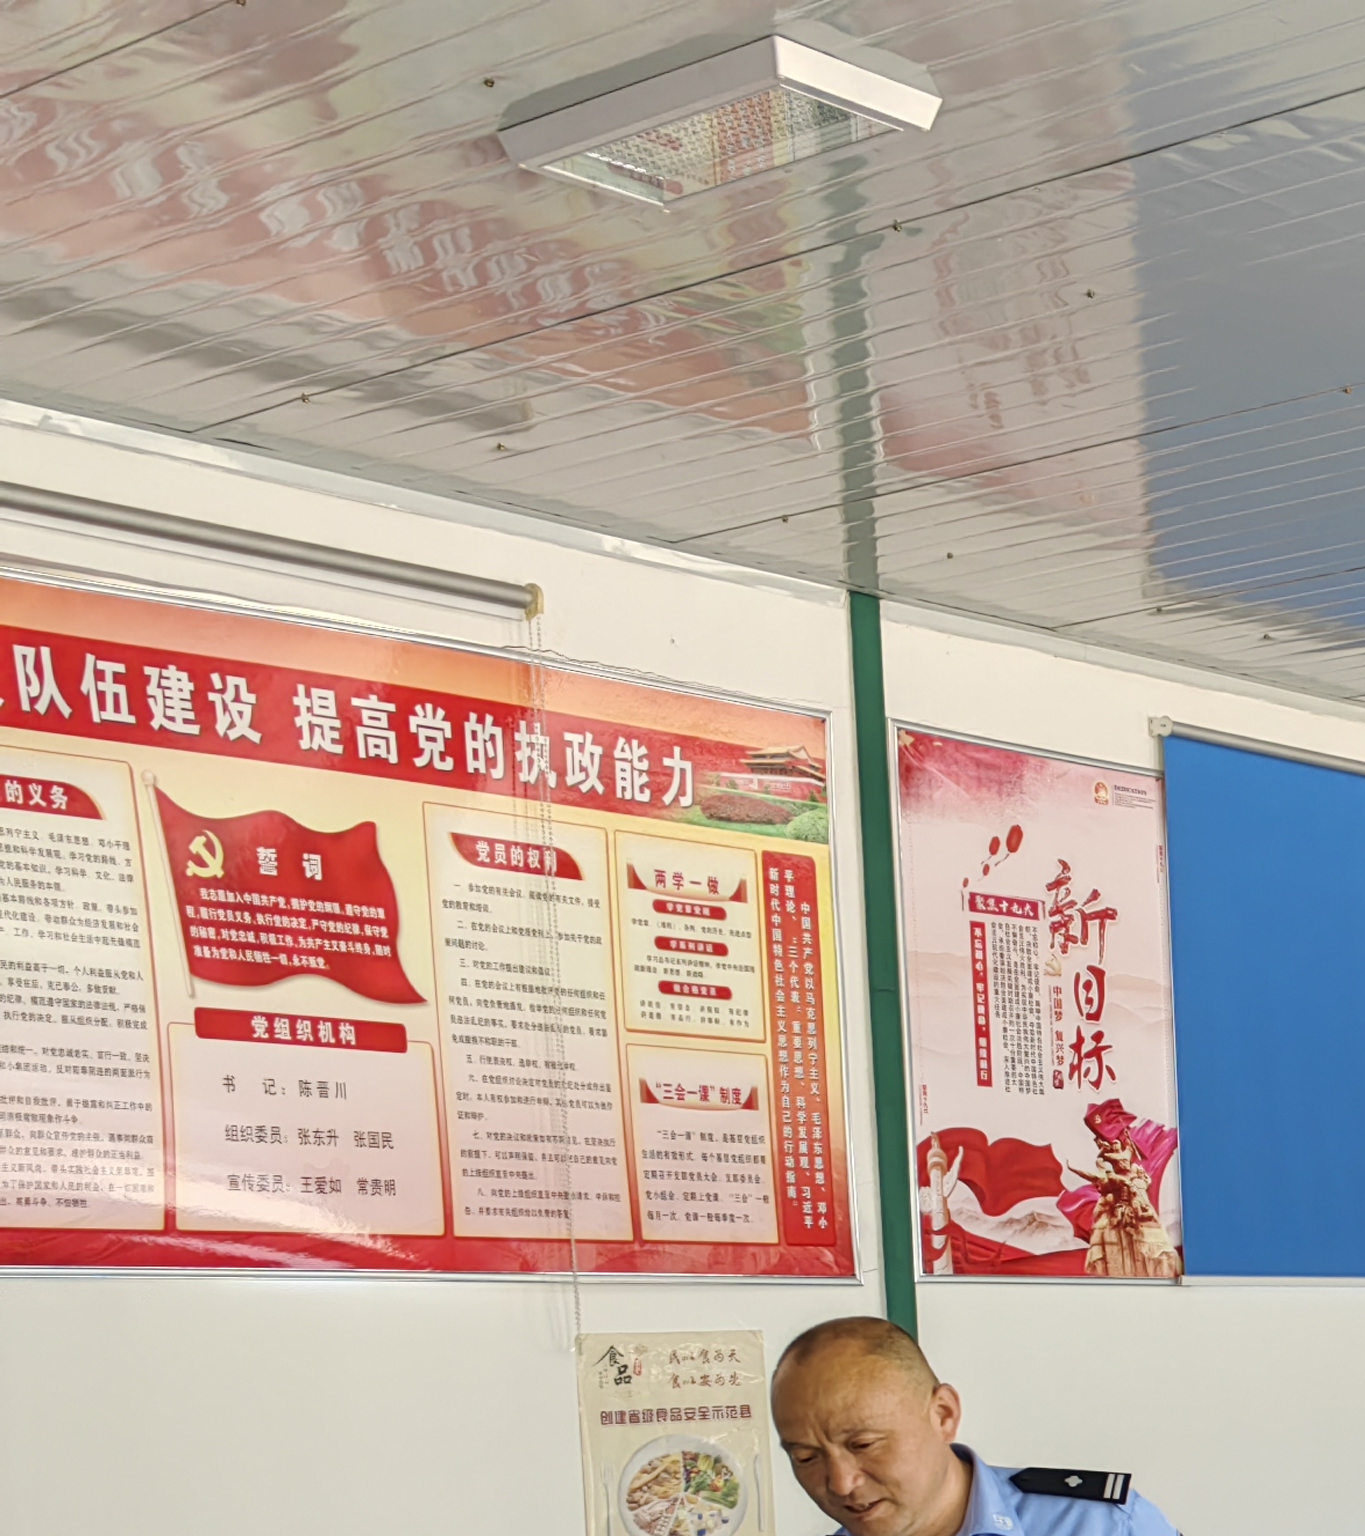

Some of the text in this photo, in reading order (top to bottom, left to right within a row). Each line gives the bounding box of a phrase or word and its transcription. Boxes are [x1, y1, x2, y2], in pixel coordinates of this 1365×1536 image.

[12, 643, 693, 808] 队伍建设 提高党的执政能力
[5, 779, 68, 810] 的义务
[256, 847, 323, 881] 誓词
[475, 840, 557, 873] 党员的权利
[654, 869, 719, 895] 两学一做
[975, 894, 1035, 917] 聚焦十九大
[1045, 858, 1118, 1091] 新目标
[251, 1015, 356, 1045] 党组织机构
[298, 1079, 347, 1100] 陈晋川
[225, 1124, 394, 1150] 组织委员: 张东升 张国民
[227, 1173, 397, 1196] 宣传委员: 王爱如 常贵明
[669, 1349, 741, 1365] 民以食为天
[670, 1371, 742, 1389] 食以安为先
[600, 1404, 752, 1426] 创建省级食品安全示范县
